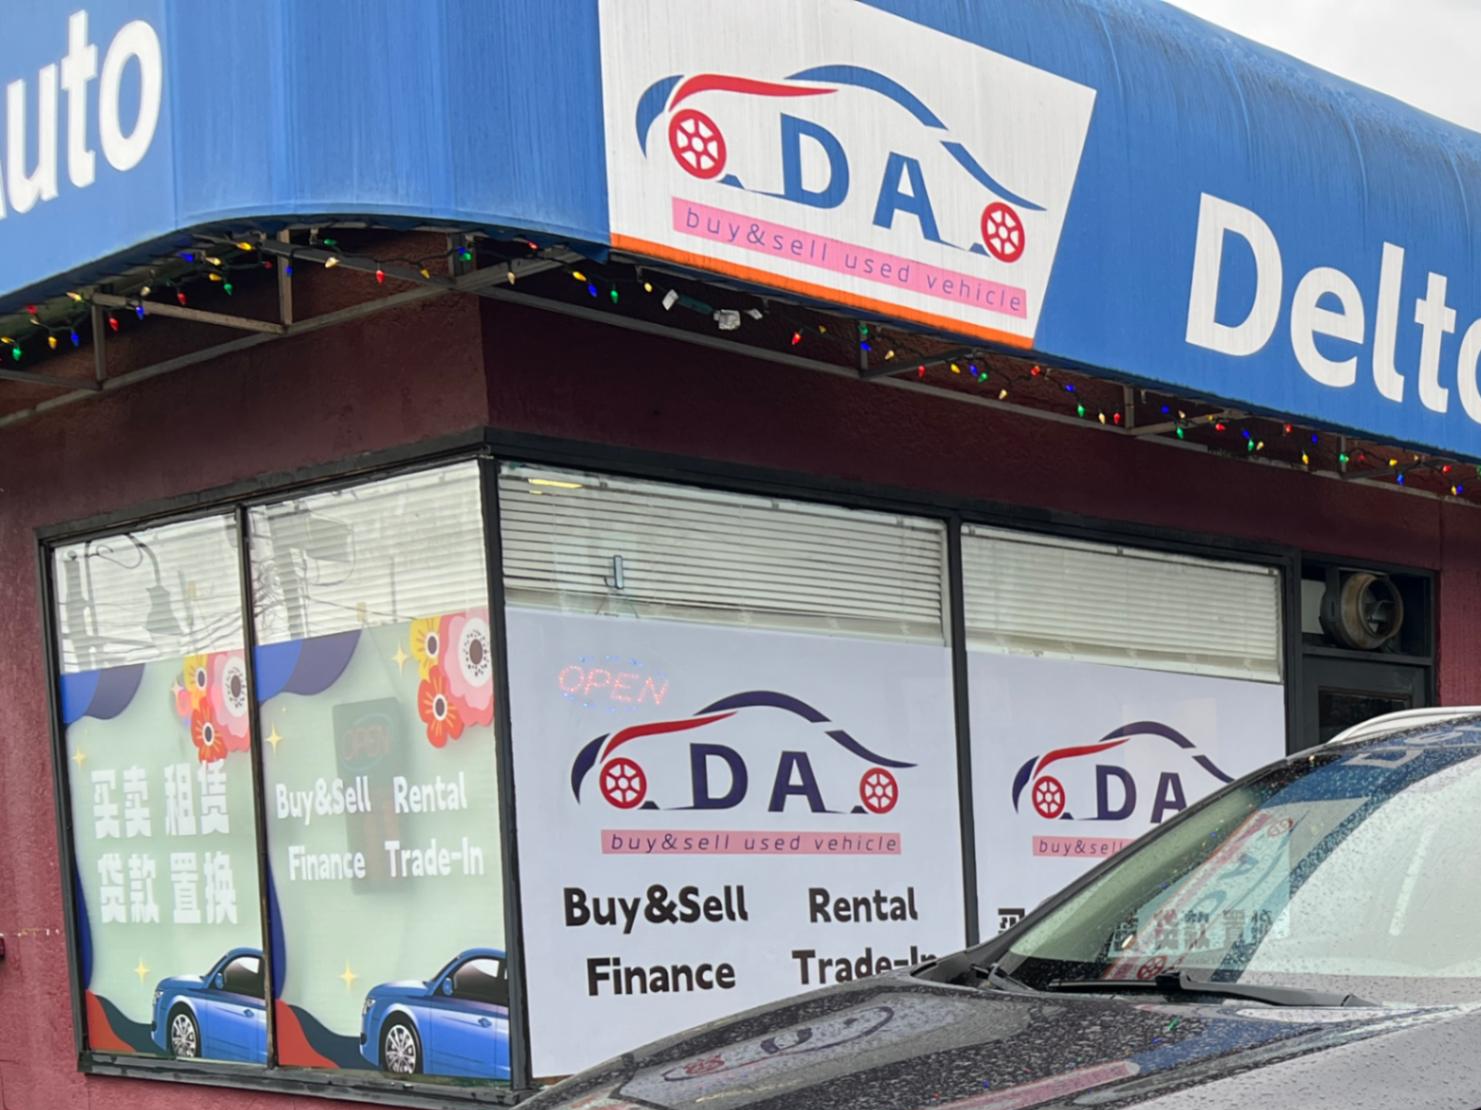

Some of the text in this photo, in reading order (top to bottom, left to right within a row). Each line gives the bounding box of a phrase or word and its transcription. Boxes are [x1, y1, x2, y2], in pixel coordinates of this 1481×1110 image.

[0, 8, 163, 218] uto
[686, 207, 1022, 312] buy&sell used vehicle
[557, 664, 670, 706] OPEN
[91, 758, 230, 839] 买卖 租赁
[275, 771, 468, 826] Buy&Sell Rental
[288, 837, 484, 881] Finance Trade-In
[610, 833, 898, 853] buy&sell used vehicle
[97, 851, 238, 924] 贷款 置换
[563, 884, 919, 934] Buy&Sell Rental
[587, 957, 736, 996] Finance
